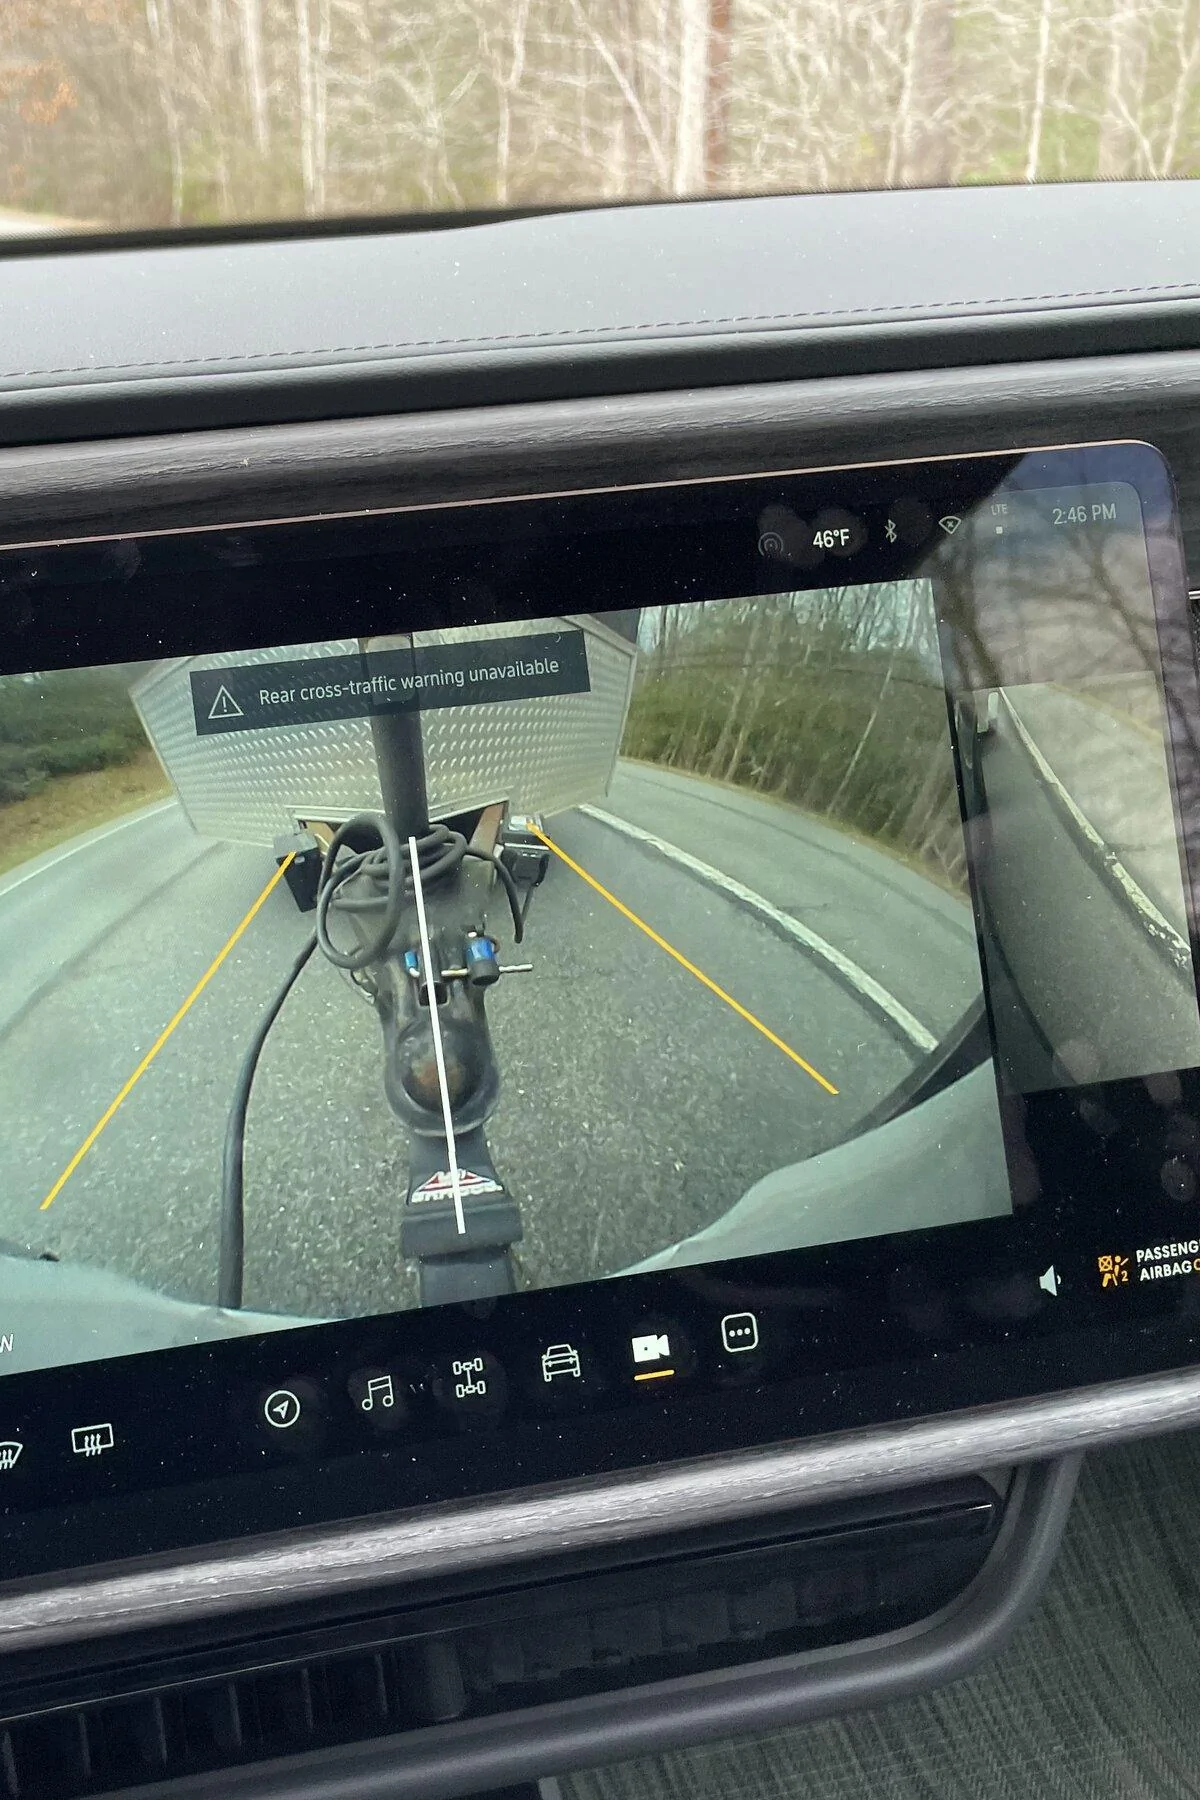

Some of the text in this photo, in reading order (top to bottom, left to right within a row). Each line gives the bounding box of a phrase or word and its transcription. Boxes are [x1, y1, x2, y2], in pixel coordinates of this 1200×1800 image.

[1052, 503, 1117, 525] 2:46 PM
[812, 528, 850, 548] 46°F
[259, 657, 559, 705] Rear cross-traffic warning unavailable
[1136, 1239, 1200, 1263] PASSENG
[1140, 1260, 1192, 1281] AIRBAG
